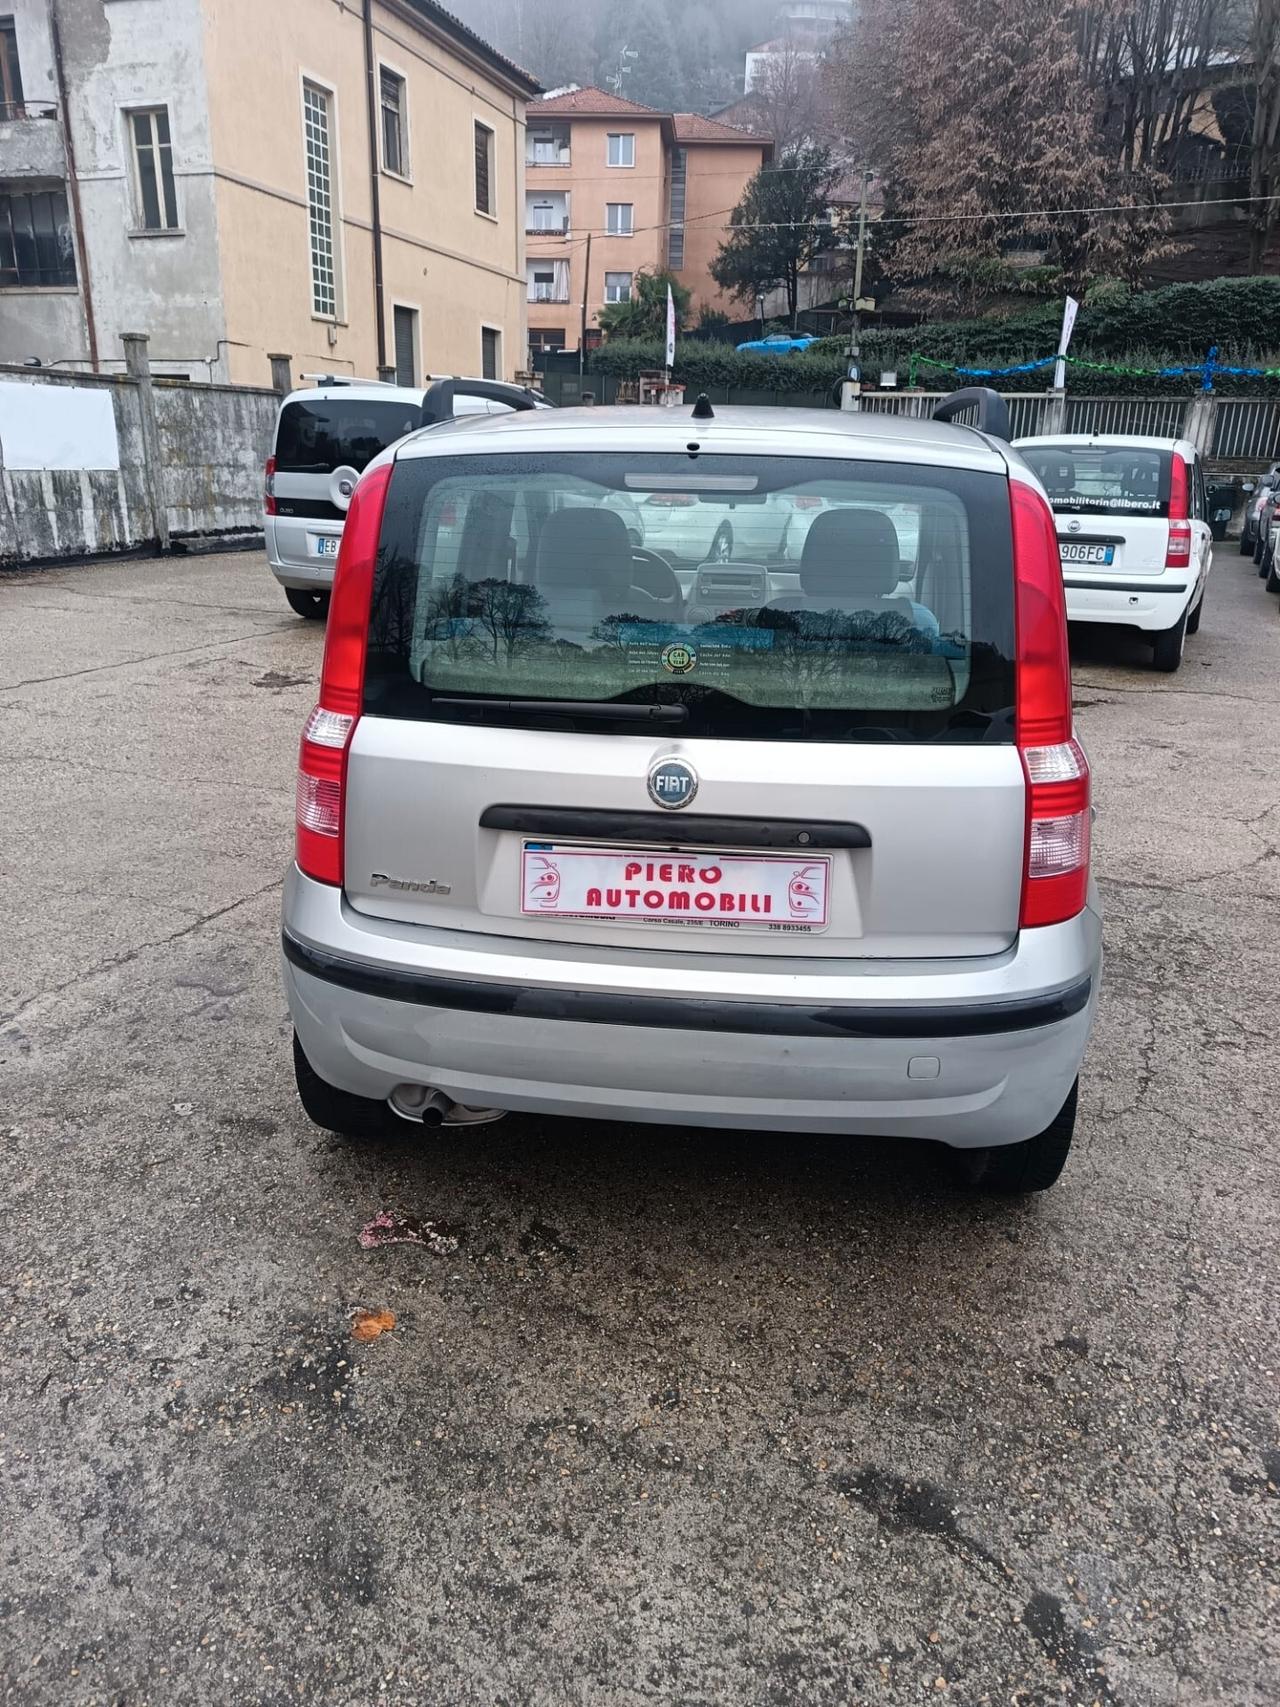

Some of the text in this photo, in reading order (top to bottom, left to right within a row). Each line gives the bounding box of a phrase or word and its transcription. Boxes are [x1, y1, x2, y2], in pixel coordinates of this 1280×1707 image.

[325, 540, 337, 553] EB
[1061, 544, 1104, 561] 906FC
[656, 775, 689, 793] FIAT
[624, 862, 722, 884] PIERO
[370, 873, 452, 895] Panda
[586, 888, 772, 913] AUTOMOBILI
[709, 920, 740, 928] TORINO
